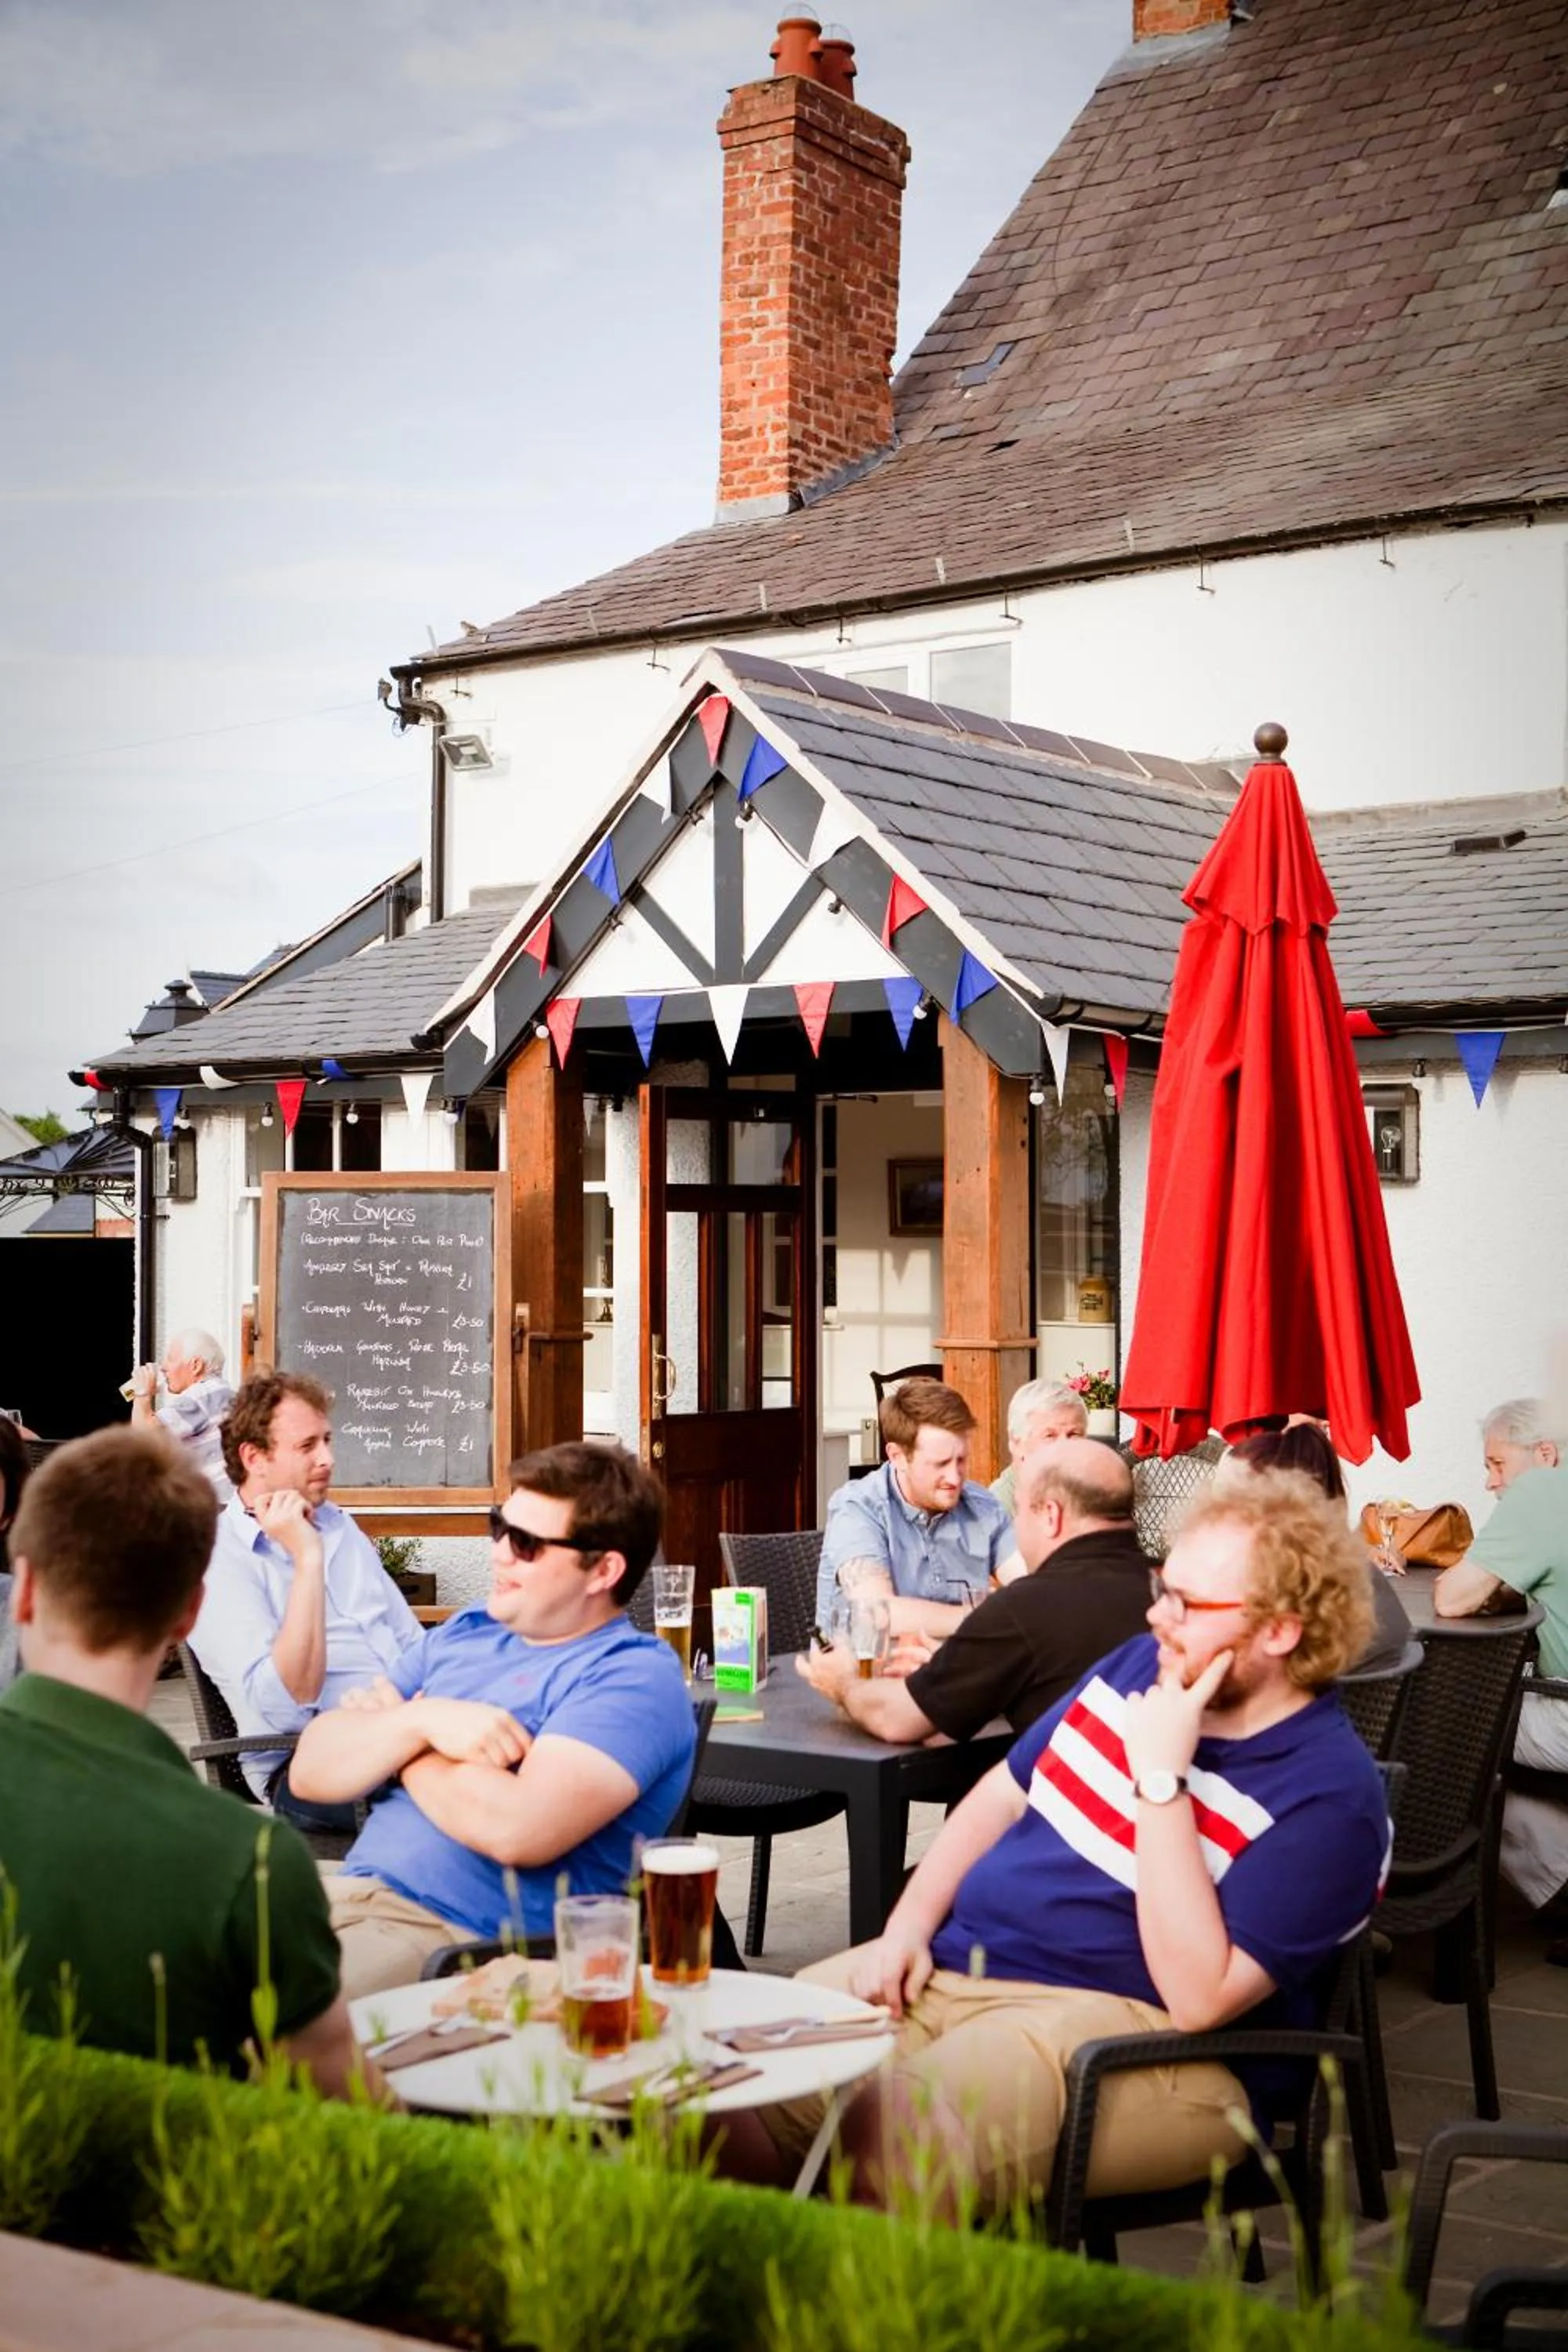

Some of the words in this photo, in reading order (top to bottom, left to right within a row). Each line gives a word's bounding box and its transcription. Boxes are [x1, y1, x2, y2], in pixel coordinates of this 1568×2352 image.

[308, 1198, 339, 1227] BAR
[353, 1198, 416, 1229] SNACKS
[456, 1272, 471, 1291] £1
